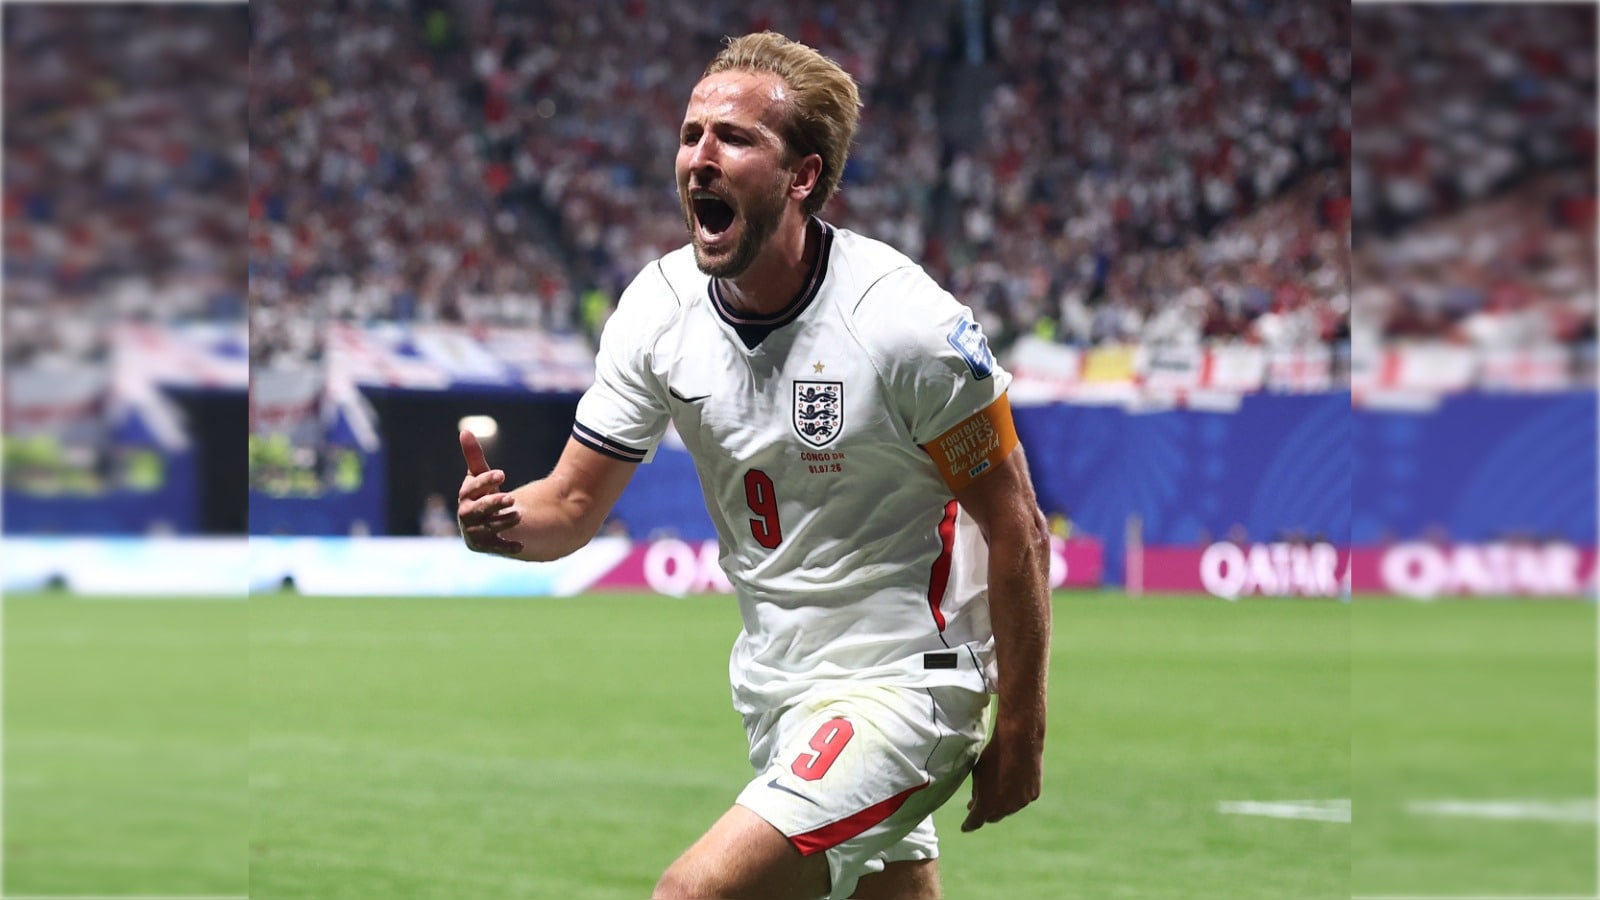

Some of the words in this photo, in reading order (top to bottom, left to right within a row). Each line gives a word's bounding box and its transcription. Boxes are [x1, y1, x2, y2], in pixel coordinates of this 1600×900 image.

[940, 413, 988, 450] FOOTBALL
[944, 422, 993, 462] UNITES
[968, 432, 999, 465] World
[801, 452, 830, 461] CONGO
[809, 464, 841, 474] 01.07.26
[970, 460, 990, 477] FIFA
[744, 468, 783, 549] 9
[1200, 541, 1338, 601] QATAR
[791, 716, 855, 781] 9
